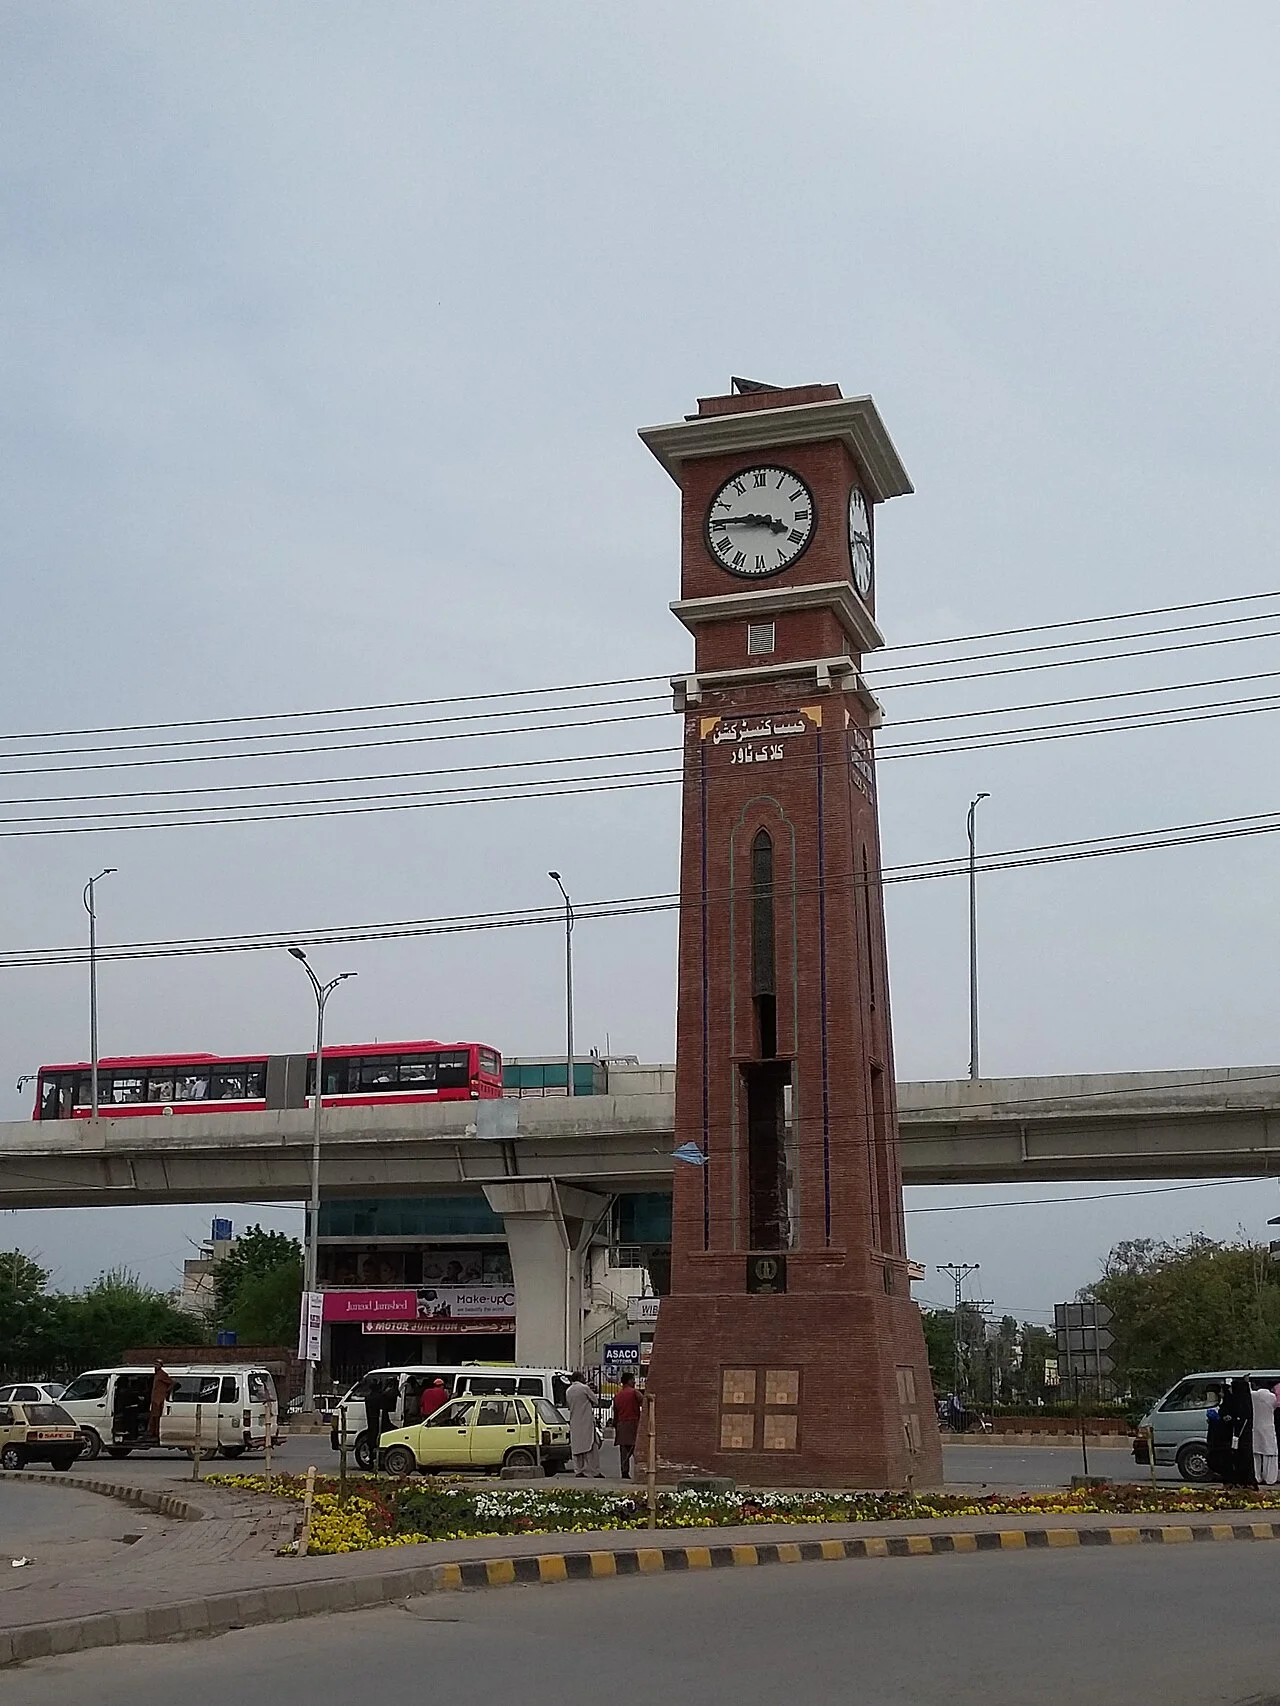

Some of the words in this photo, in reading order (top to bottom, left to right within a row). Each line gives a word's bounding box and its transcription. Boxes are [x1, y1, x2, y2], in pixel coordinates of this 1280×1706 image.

[753, 473, 766, 488] XII
[732, 480, 747, 497] XI
[788, 489, 803, 502] II
[794, 510, 808, 521] III
[755, 555, 766, 569] VI
[375, 1322, 409, 1331] MOTOR
[606, 1349, 638, 1359] ASACO
